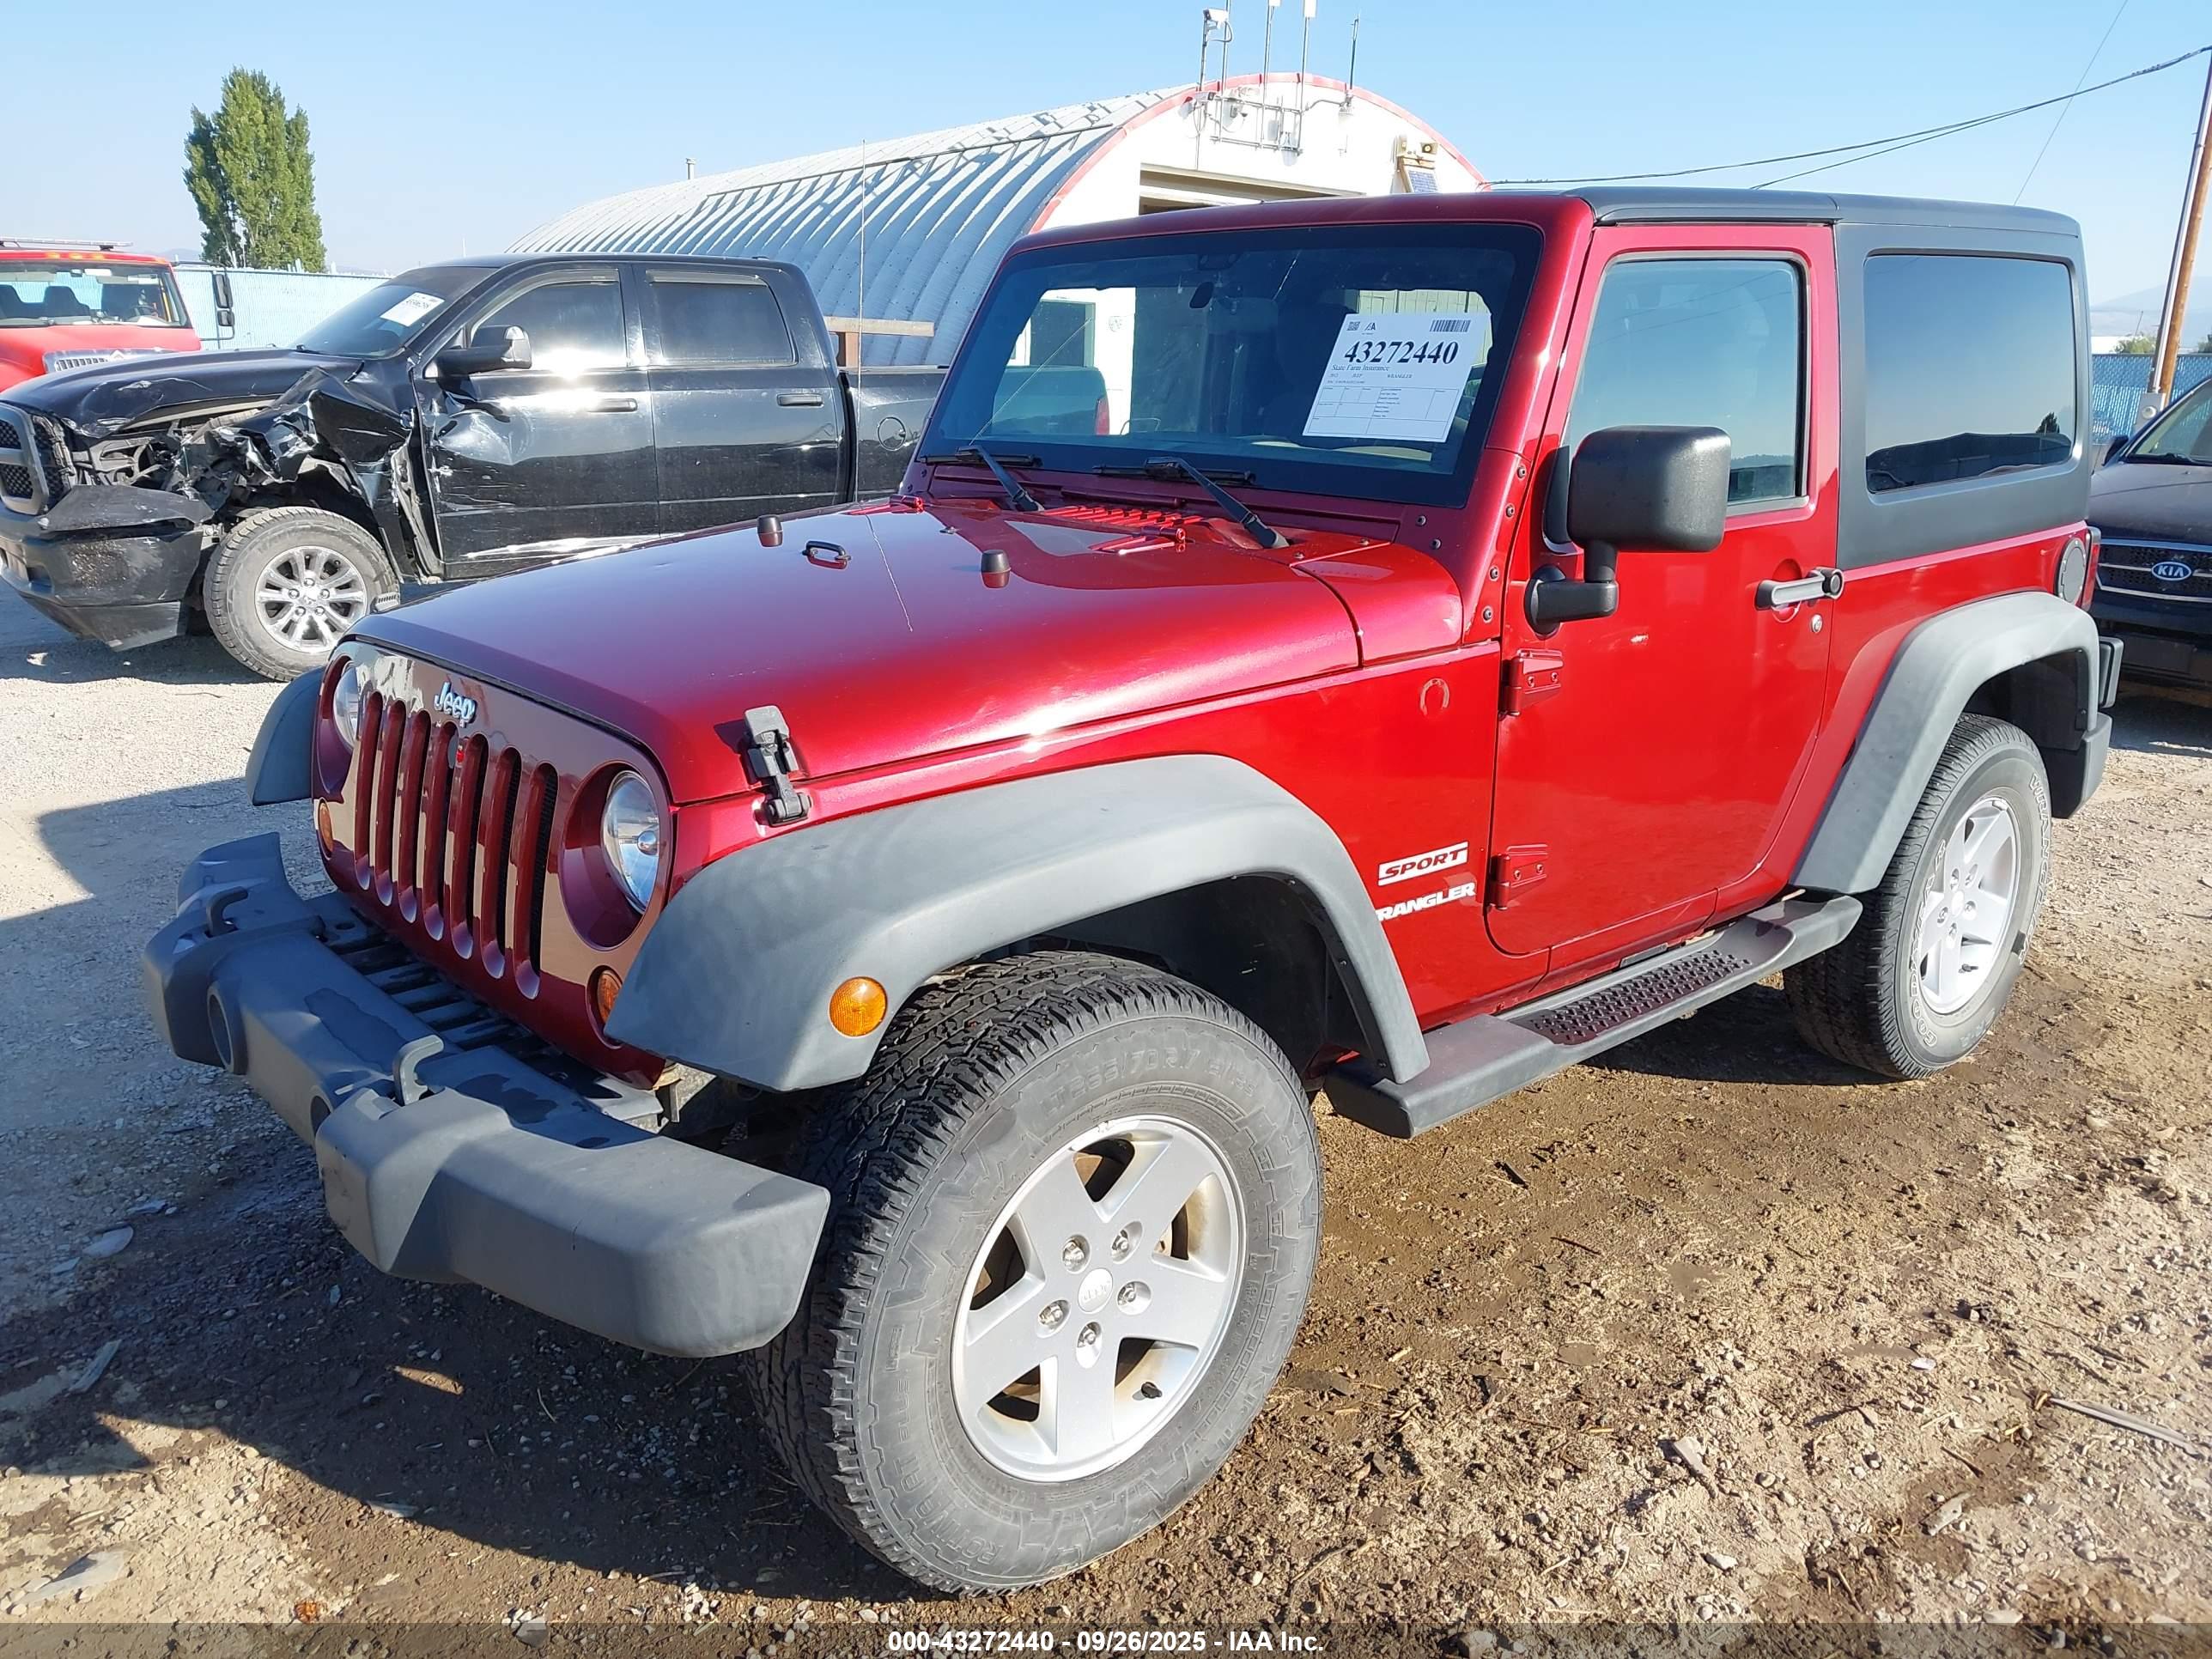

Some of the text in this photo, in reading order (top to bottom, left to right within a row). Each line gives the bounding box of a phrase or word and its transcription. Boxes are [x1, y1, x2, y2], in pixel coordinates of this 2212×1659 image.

[1344, 341, 1459, 364] 43272440
[2157, 565, 2184, 577] KIA
[434, 681, 476, 728] Jeep
[1382, 848, 1467, 878] SPORT
[1375, 882, 1476, 921] RANGLER
